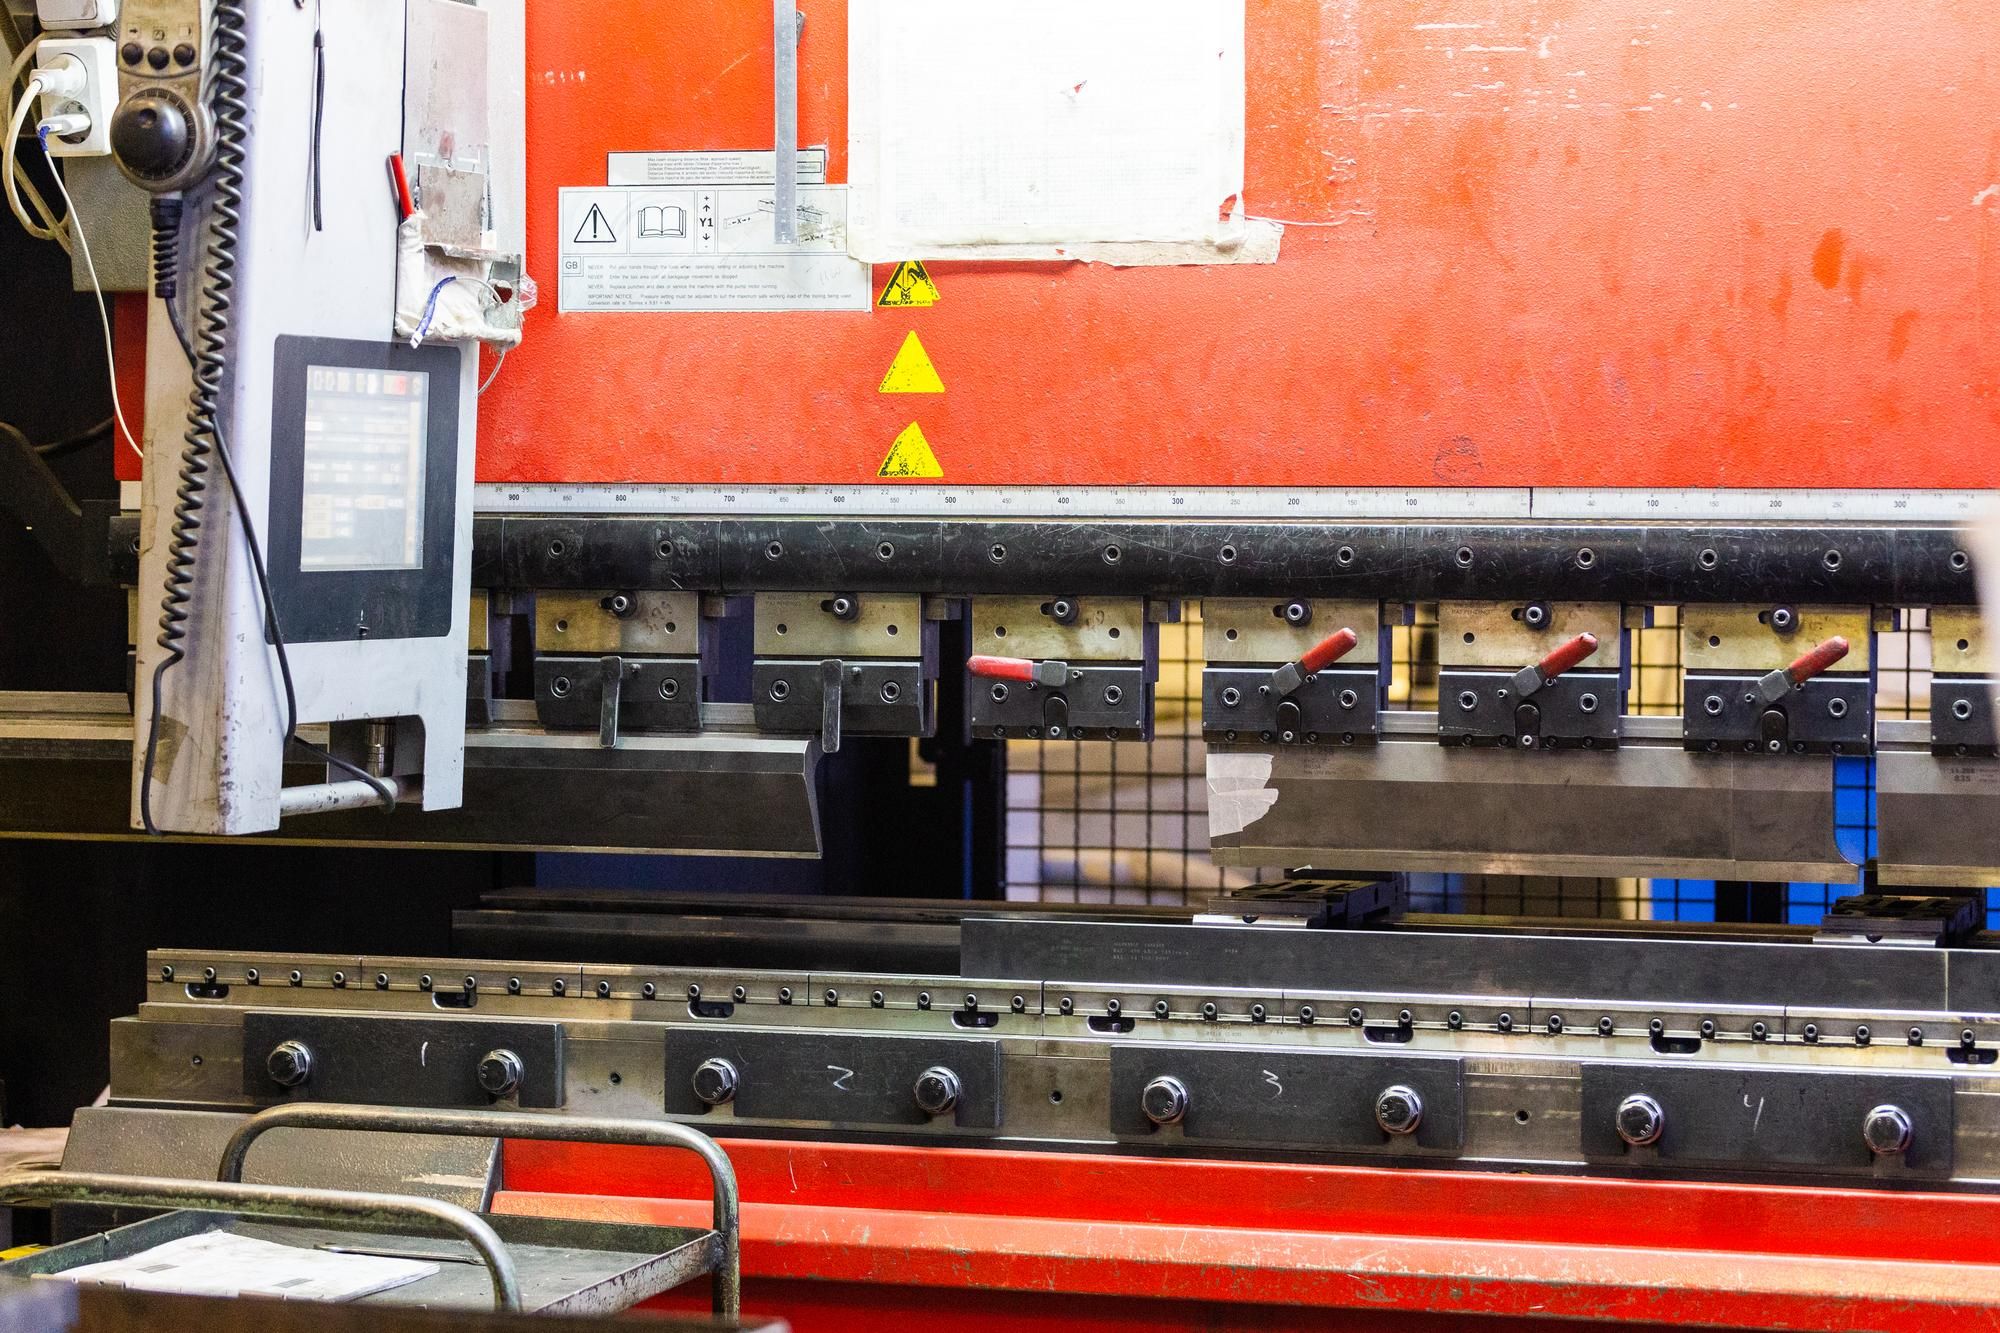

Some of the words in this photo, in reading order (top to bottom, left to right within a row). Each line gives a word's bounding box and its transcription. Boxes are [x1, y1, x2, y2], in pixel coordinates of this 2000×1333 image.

[699, 217, 714, 228] Y1
[565, 261, 578, 270] GB
[945, 496, 957, 504] 500
[1172, 497, 1184, 505] 300
[1405, 498, 1418, 506] 100
[1769, 500, 1783, 508] 200
[827, 1065, 854, 1090] 2
[1262, 1069, 1283, 1097] 3
[1743, 1095, 1765, 1132] 4
